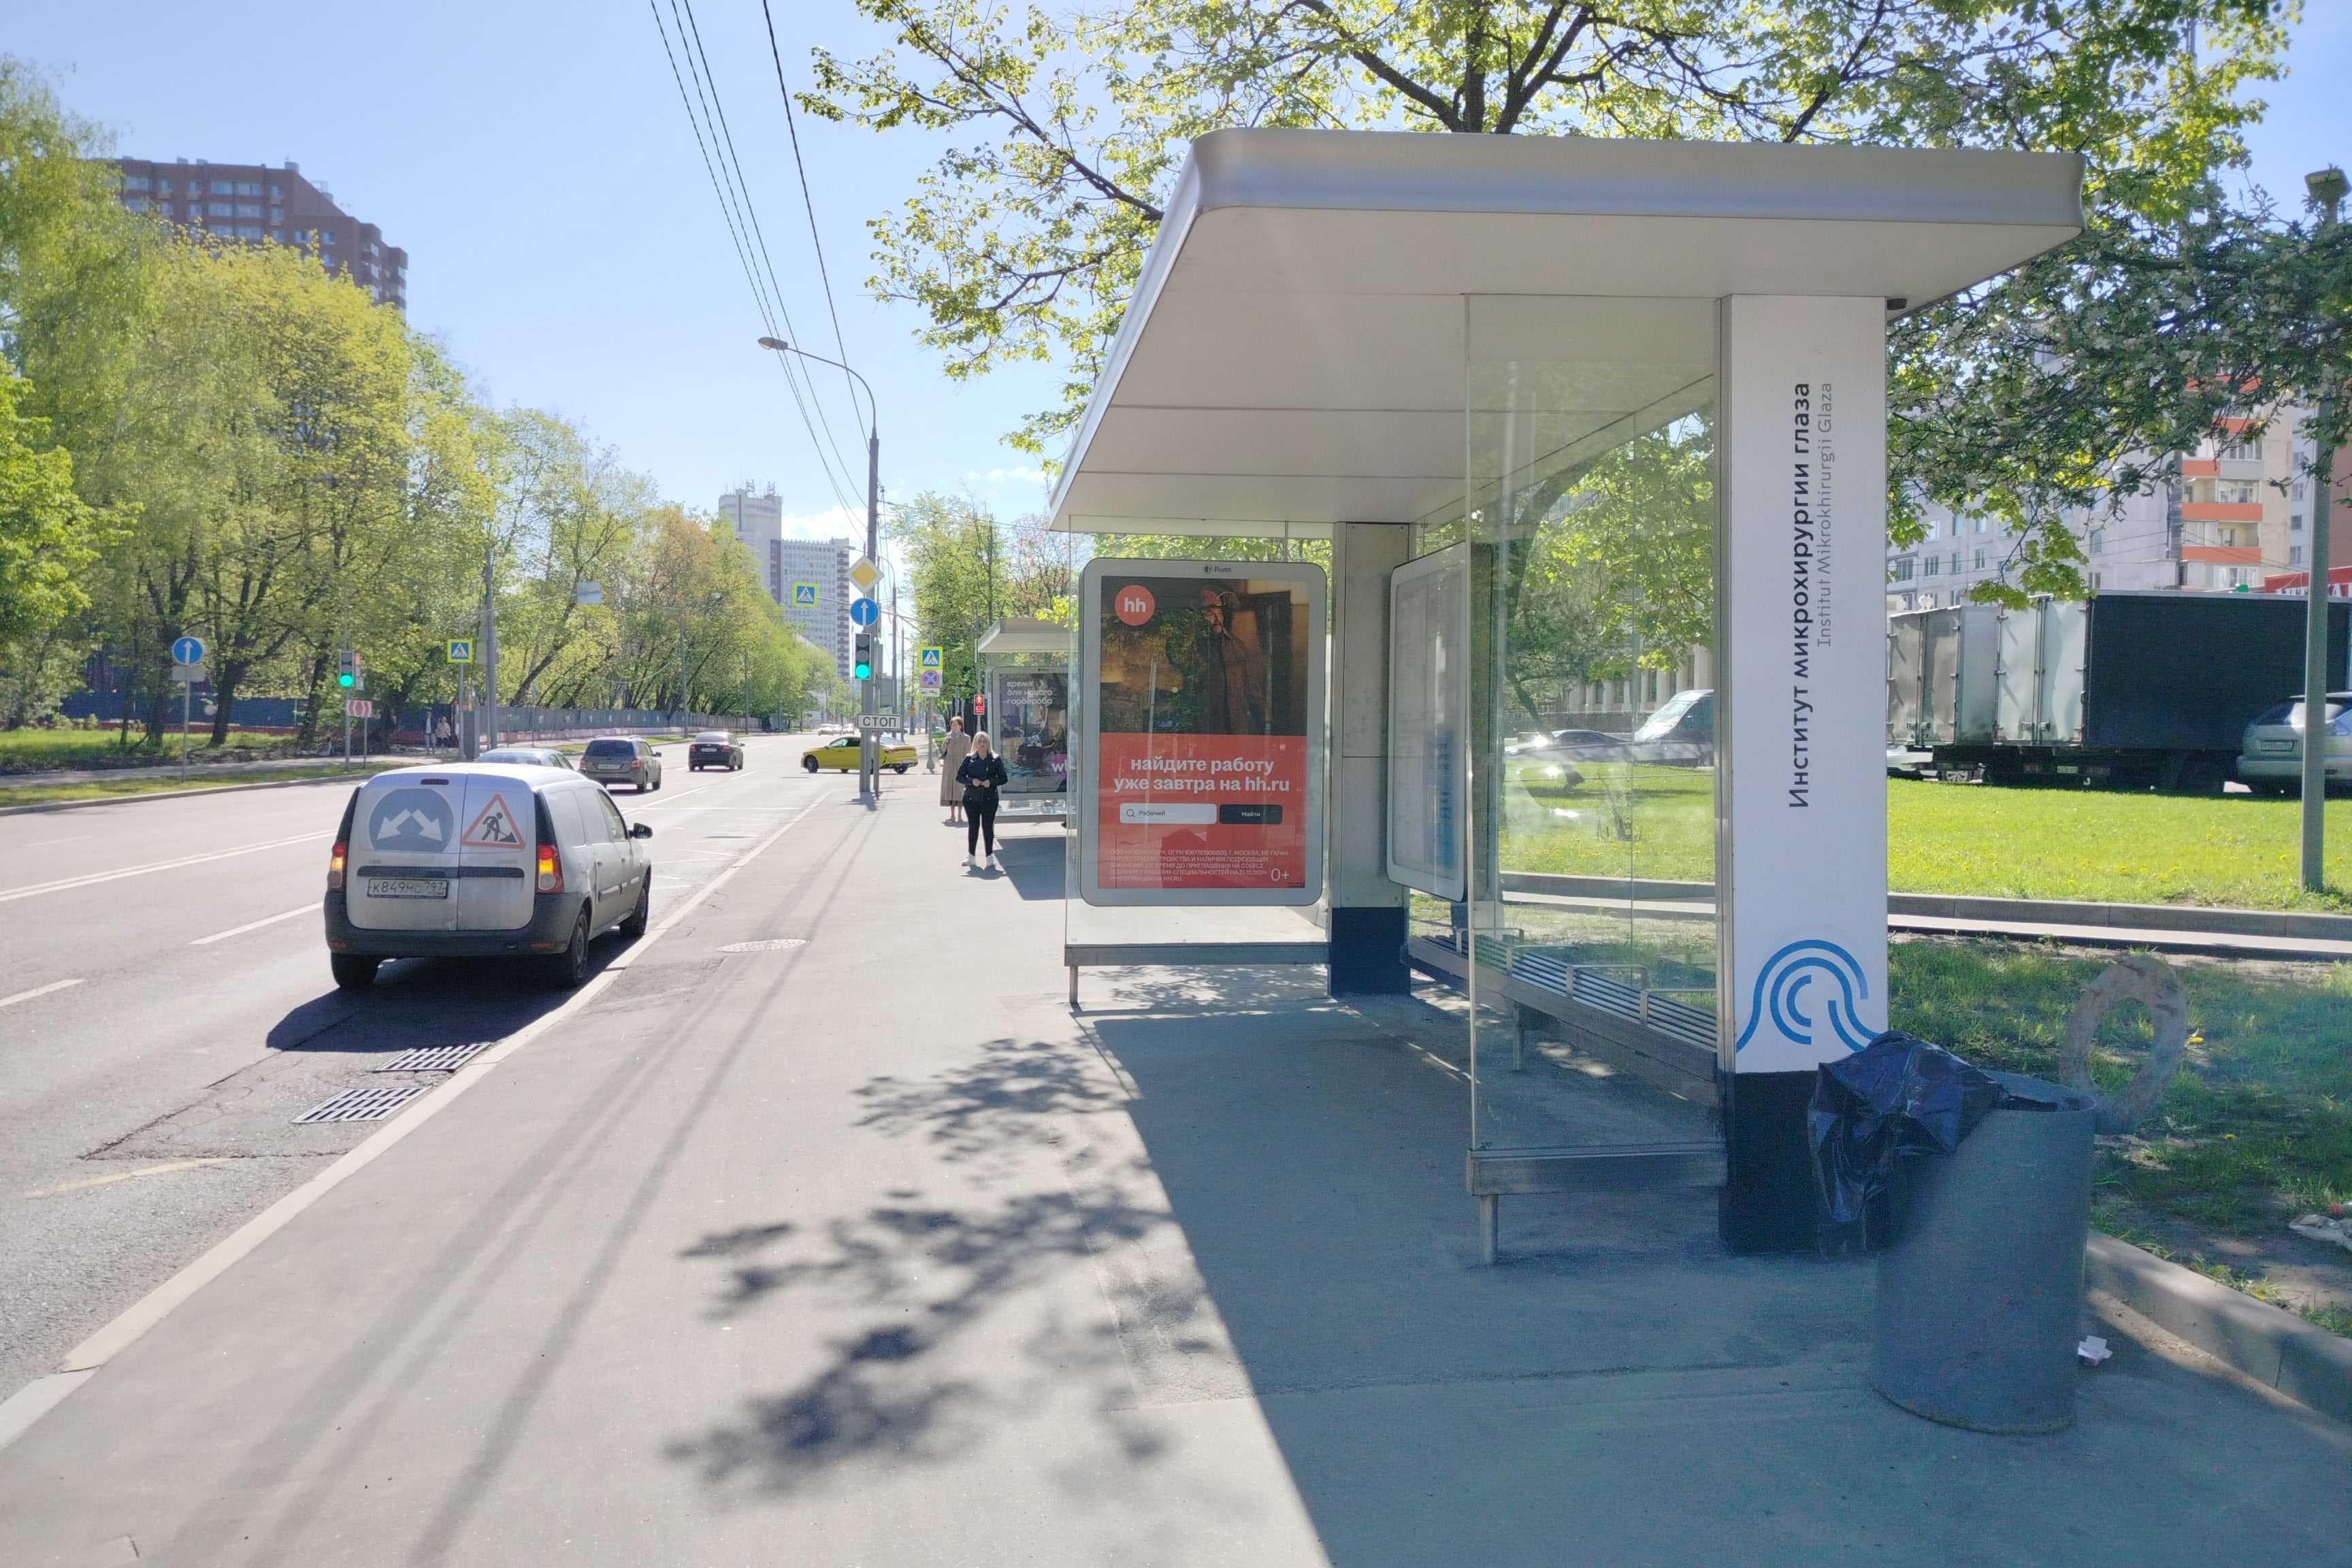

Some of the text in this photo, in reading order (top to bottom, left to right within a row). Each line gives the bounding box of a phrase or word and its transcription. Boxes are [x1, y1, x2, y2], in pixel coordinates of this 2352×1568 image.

[1816, 382, 1835, 647] Institut Mikrokhirurgii Glaza
[1788, 383, 1814, 807] Институт микрохирургии глаза
[1124, 597, 1146, 612] hh
[1007, 681, 1034, 689] время
[863, 717, 896, 727] СТОП
[1130, 755, 1275, 774] найдите работу
[1113, 776, 1290, 794] уже завтра на hh.ru
[1139, 809, 1166, 817] Рабочий
[1271, 868, 1290, 881] 0+
